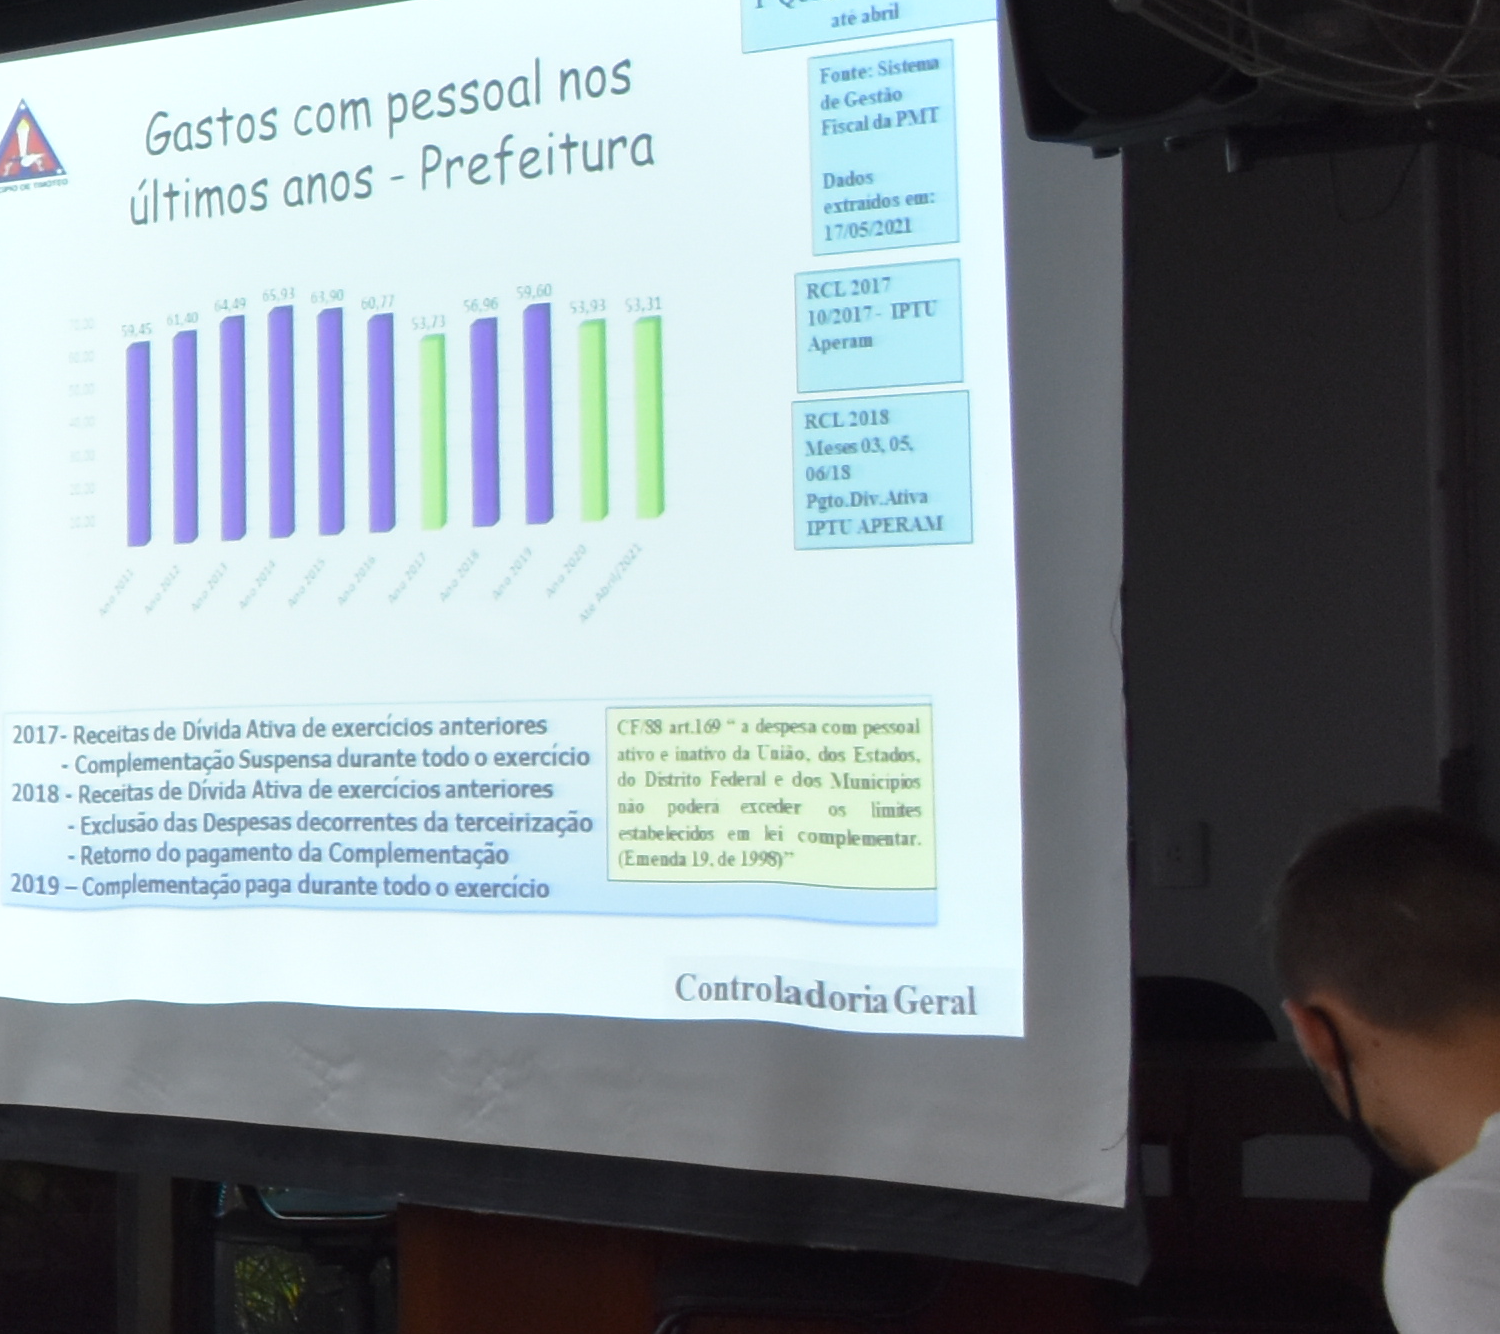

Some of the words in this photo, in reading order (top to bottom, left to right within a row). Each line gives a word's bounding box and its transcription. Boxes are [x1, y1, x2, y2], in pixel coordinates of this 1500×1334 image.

[861, 2, 899, 24] abril
[820, 66, 873, 85] Fonte:
[878, 57, 940, 77] Sistema
[145, 106, 279, 157] Gastos
[294, 94, 373, 136] com
[387, 57, 541, 139] pessoal
[559, 56, 632, 101] nos
[820, 94, 840, 111] de
[844, 87, 903, 108] Gestão
[821, 114, 869, 136] Fiscal
[873, 113, 891, 129] da
[896, 106, 939, 128] PMT
[129, 172, 268, 226] últimos
[283, 163, 374, 208] anos
[421, 128, 655, 192] Prefeitura
[822, 171, 874, 189] Dados
[905, 192, 935, 206] em:
[825, 217, 912, 241] 17/05/2021
[262, 287, 295, 302] 65,93
[806, 281, 846, 300] RCL
[851, 276, 891, 296] 2017
[891, 299, 938, 320] IPTU
[807, 335, 874, 355] Aperam
[804, 412, 844, 430] RCL
[849, 409, 890, 427] 2018
[805, 440, 857, 457] Meses
[806, 464, 851, 482] 06/18
[807, 518, 852, 536] IPTU
[857, 515, 944, 534] APERAM
[73, 724, 149, 745] Receitas
[153, 720, 176, 741] de
[183, 718, 241, 741] Dívida
[246, 719, 296, 739] Ativa
[302, 717, 326, 738] de
[332, 713, 433, 738] exercícios
[439, 716, 548, 736] anteriores
[741, 722, 749, 734] a
[755, 718, 816, 738] despesa
[822, 722, 857, 735] com
[863, 718, 920, 739] pessoal
[75, 749, 235, 777] Complementação
[239, 749, 332, 774] Suspensa
[337, 747, 417, 768] durante
[422, 745, 469, 767] todo
[474, 752, 488, 767] o
[494, 742, 591, 767] exercício
[617, 747, 655, 762] ativo
[660, 750, 669, 761] e
[675, 746, 726, 761] inativo
[732, 745, 750, 760] da
[818, 745, 846, 763] dos
[617, 771, 636, 787] do
[645, 770, 702, 787] Distrito
[710, 770, 766, 787] Federal
[774, 774, 784, 787] e
[792, 770, 822, 788] dos
[12, 783, 60, 803] 2018
[78, 783, 154, 804] Receitas
[158, 780, 182, 800] de
[188, 778, 246, 801] Dívida
[252, 780, 302, 799] Ativa
[308, 778, 332, 799] de
[338, 776, 440, 799] exercícios
[445, 779, 554, 799] anteriores
[740, 798, 802, 815] exceder
[828, 804, 847, 817] os
[871, 801, 922, 818] limites
[81, 811, 158, 836] Exclusão
[164, 811, 197, 833] das
[203, 812, 291, 837] Despesas
[296, 810, 417, 832] decorrentes
[424, 810, 448, 832] da
[456, 810, 593, 838] terceirização
[618, 825, 715, 841] estabelecidos
[727, 829, 750, 841] em
[764, 824, 784, 842] lei
[81, 846, 151, 865] Retorno
[156, 841, 181, 863] do
[186, 843, 293, 868] pagamento
[299, 841, 322, 862] da
[329, 841, 509, 870] Complementação
[618, 849, 687, 869] (Emenda
[717, 850, 736, 867] de
[10, 872, 60, 896] 2019
[82, 872, 241, 900] Complementação
[245, 878, 292, 898] paga
[298, 873, 377, 895] durante
[383, 874, 430, 896] todo
[436, 882, 449, 897] o
[455, 874, 550, 898] exercício
[675, 972, 888, 1014] Controladoria
[893, 984, 977, 1016] Geral
